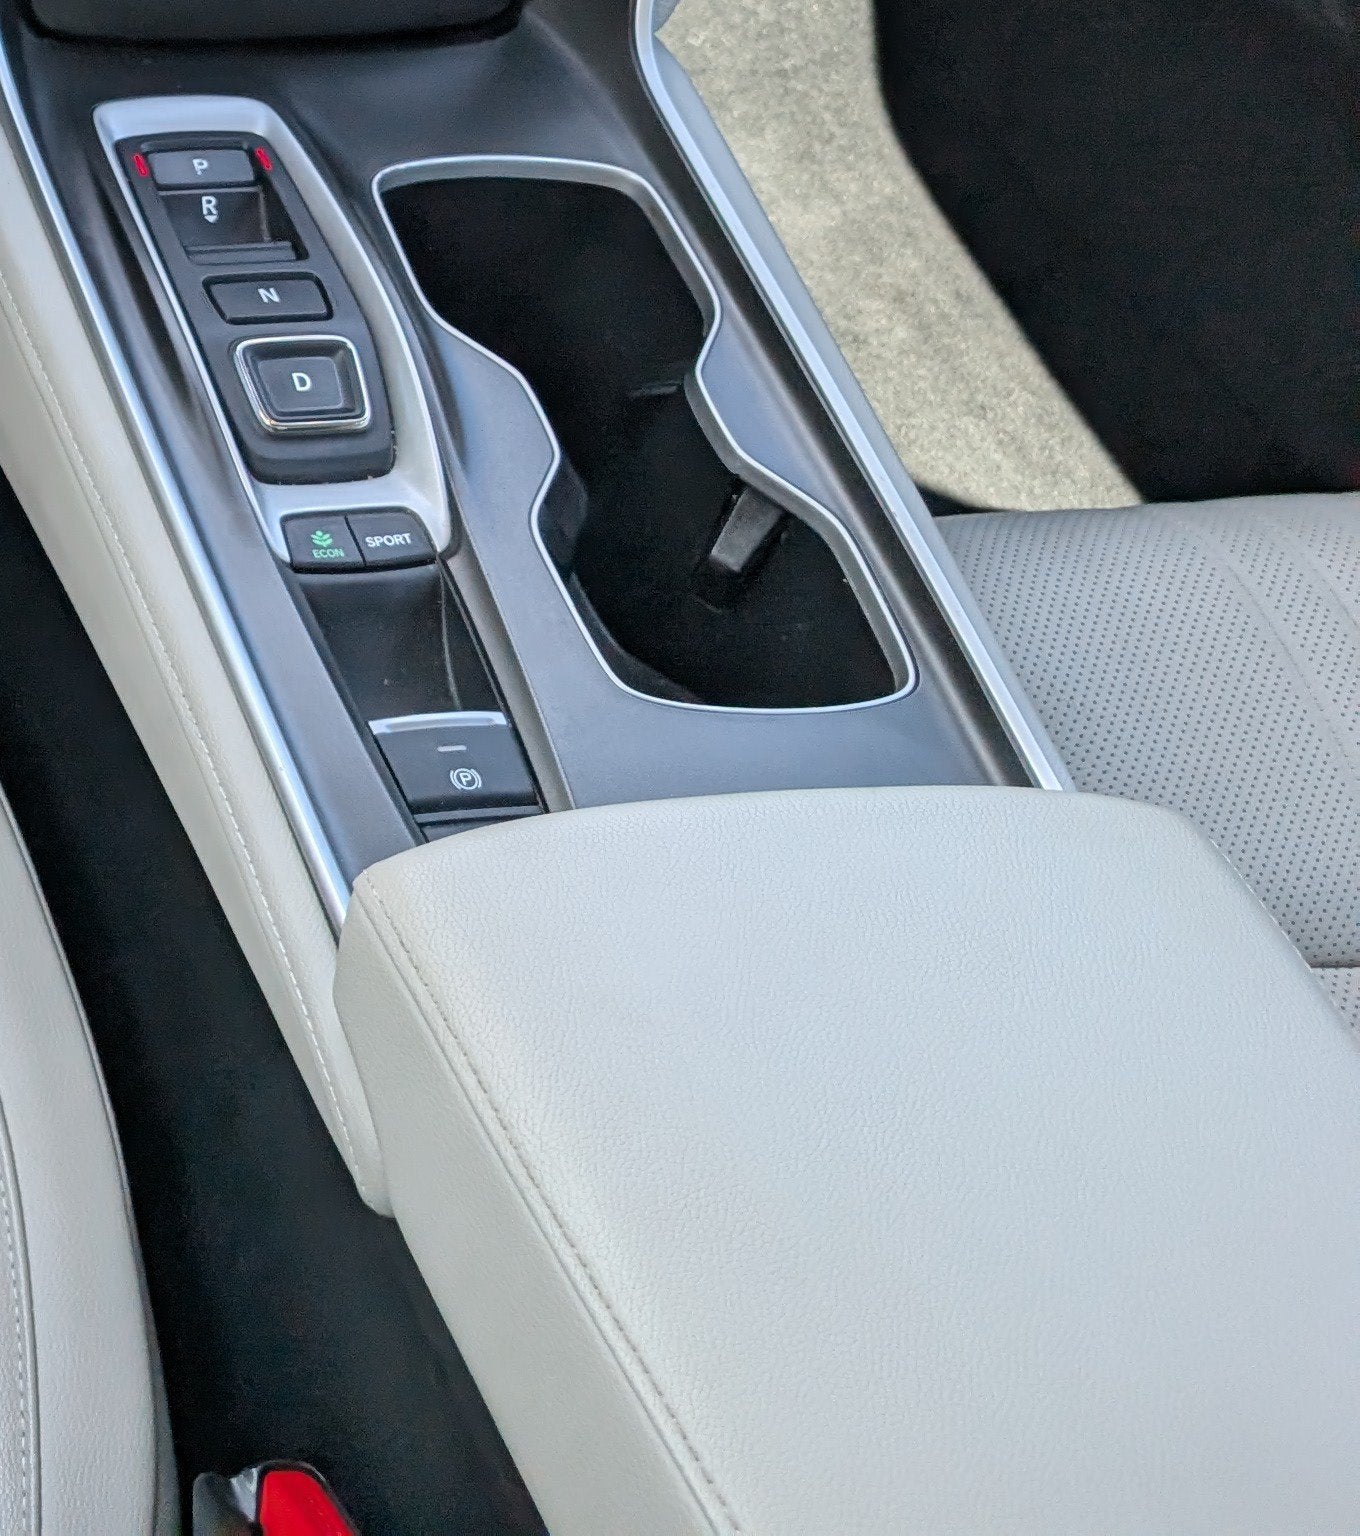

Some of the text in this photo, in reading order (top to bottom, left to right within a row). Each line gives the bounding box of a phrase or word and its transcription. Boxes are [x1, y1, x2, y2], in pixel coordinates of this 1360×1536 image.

[191, 158, 209, 176] P
[201, 195, 219, 216] R
[257, 287, 281, 304] N
[291, 372, 313, 392] D
[364, 532, 412, 548] SPORT
[311, 548, 345, 559] ECON
